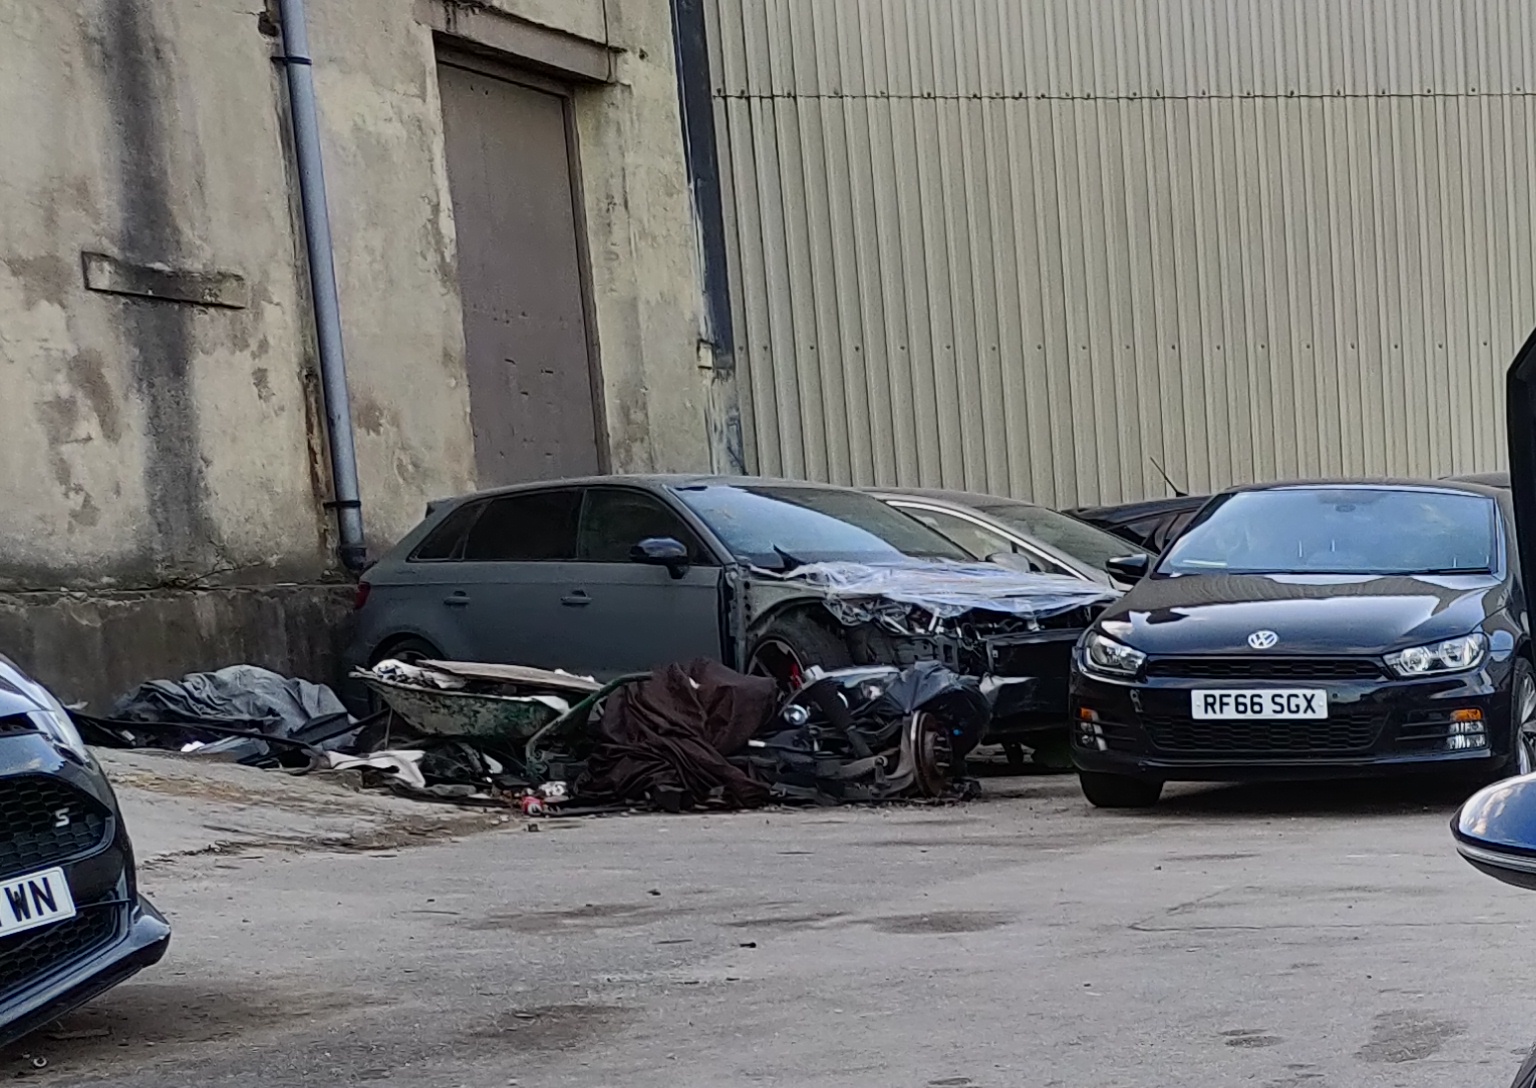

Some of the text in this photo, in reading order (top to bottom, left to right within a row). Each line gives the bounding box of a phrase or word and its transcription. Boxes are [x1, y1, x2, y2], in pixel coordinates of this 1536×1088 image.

[1203, 693, 1317, 715] RF66 SGX
[0, 876, 58, 928] WN
